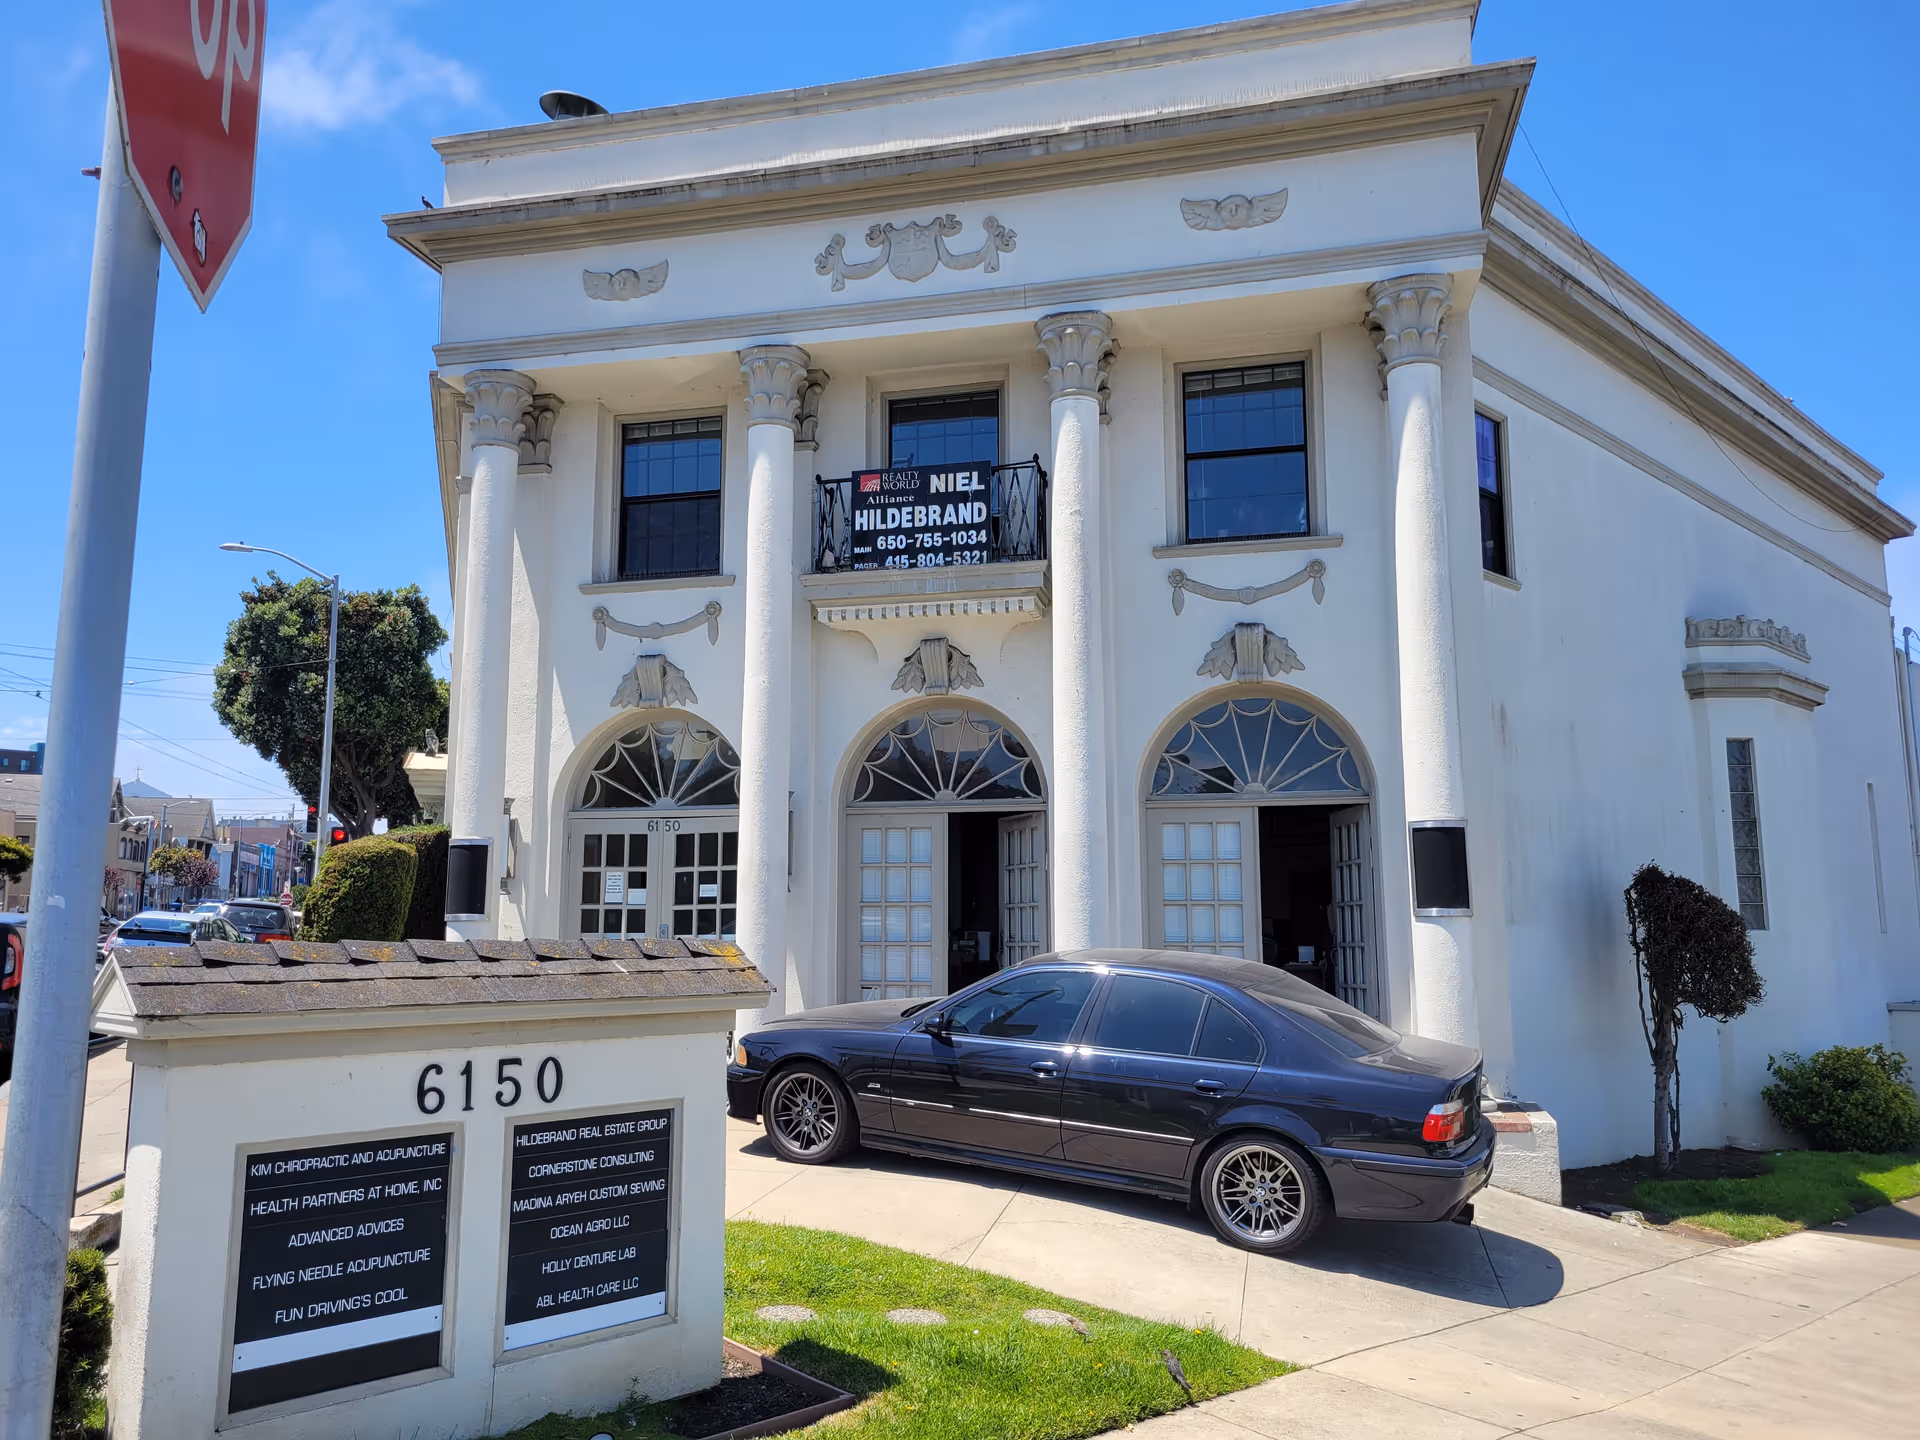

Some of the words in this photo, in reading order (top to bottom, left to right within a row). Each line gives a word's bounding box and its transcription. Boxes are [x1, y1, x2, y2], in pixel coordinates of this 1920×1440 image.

[882, 471, 919, 481] REALTY
[882, 480, 920, 490] WORLD
[930, 472, 985, 493] NIEL
[866, 494, 914, 504] Alliance
[855, 502, 987, 531] HILDEBRAND
[877, 530, 987, 549] 650-755-1034
[885, 550, 987, 569] 415-804-5321
[417, 1057, 563, 1114] 6150
[516, 1129, 576, 1147] HILDEBRAND
[580, 1126, 602, 1138] REAL
[605, 1122, 635, 1136] ESTATE
[638, 1118, 667, 1131] GROUP
[251, 1164, 271, 1176] KIM
[275, 1155, 349, 1173] CHIROPRACTIC
[352, 1152, 373, 1165] AND
[376, 1143, 446, 1162] ACUPUNCTURE
[529, 1158, 597, 1177] CORNERSTONE
[600, 1150, 654, 1168] CONSULTING
[251, 1198, 298, 1215] HEALTH
[303, 1189, 364, 1208] PARTNERS
[368, 1186, 382, 1199] AT
[385, 1182, 419, 1196] HOME,
[424, 1178, 442, 1191] INC
[513, 1195, 552, 1212] MADINA
[555, 1191, 586, 1206] ARYEH
[590, 1185, 627, 1201] CUSTOM
[630, 1179, 665, 1194] SEWING
[288, 1226, 353, 1247] ADVANCED
[357, 1218, 404, 1236] ADVICES
[551, 1223, 583, 1239] OCEAN
[586, 1219, 611, 1232] AGRO
[614, 1215, 630, 1228] LLC
[253, 1271, 294, 1290] FLYING
[299, 1263, 343, 1282] NEEDLE
[347, 1248, 431, 1274] ACUPUNCTURE
[542, 1258, 572, 1274] HOLLY
[574, 1250, 616, 1268] DENTURE
[619, 1247, 636, 1259] LAB
[275, 1308, 303, 1323] FUN
[308, 1294, 371, 1317] DRIVING'S
[375, 1288, 408, 1305] COOL
[536, 1294, 555, 1308] ABL
[558, 1286, 594, 1304] HEALTH
[597, 1281, 620, 1295] CARE
[623, 1277, 639, 1290] LLC
